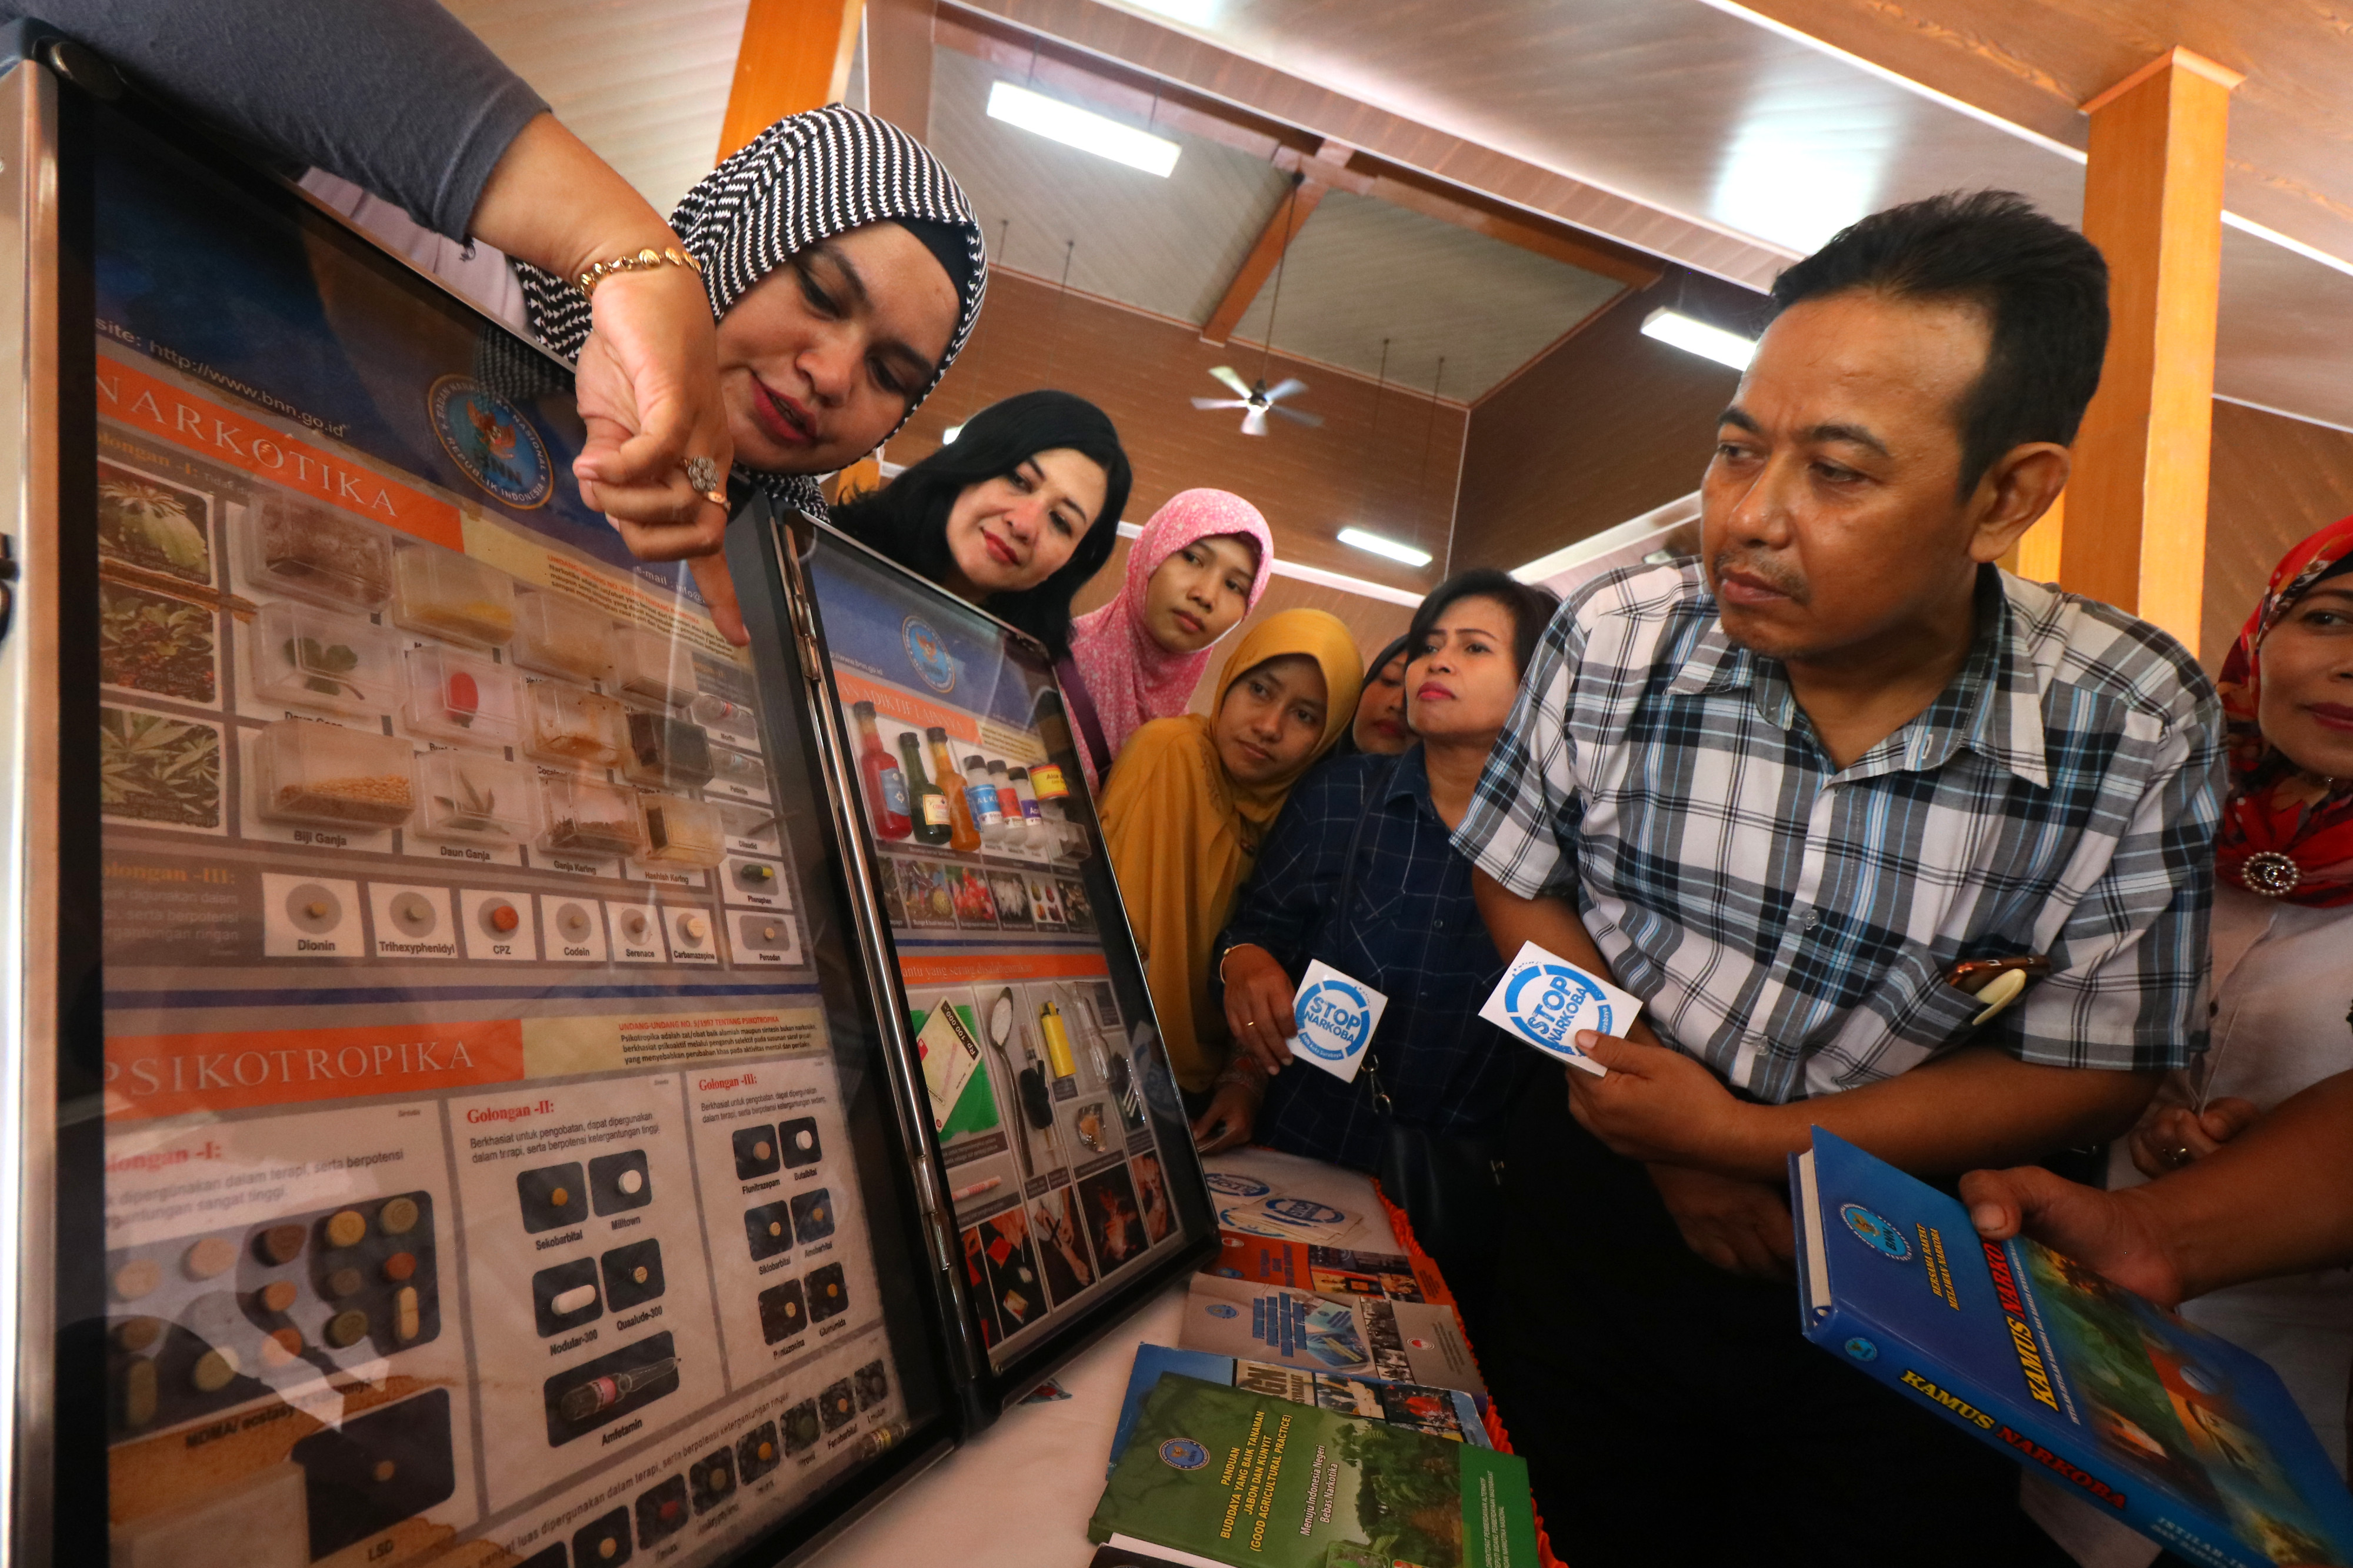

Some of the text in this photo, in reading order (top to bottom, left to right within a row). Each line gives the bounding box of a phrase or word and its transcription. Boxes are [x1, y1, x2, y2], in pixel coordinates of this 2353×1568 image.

[501, 483, 545, 502] INDONESIA
[636, 565, 666, 585] e-mail
[295, 830, 347, 848] Biji Ganja
[440, 846, 491, 862] Daun Ganja
[554, 860, 597, 875] Ganja Kering
[297, 939, 336, 952] Dionin
[379, 941, 455, 955] Trihexyphenidyl
[493, 945, 511, 955] CPZ
[564, 947, 590, 958] Codein
[625, 949, 655, 959] Serenace
[673, 950, 715, 960] Carbamazepine
[758, 953, 781, 962] Percodan
[902, 966, 922, 978] antu
[926, 966, 946, 980] yang
[950, 963, 975, 979] sering
[1310, 996, 1361, 1030] STOP
[1527, 976, 1571, 1035] STOP
[1548, 987, 1588, 1043] NARKOBA
[619, 1020, 679, 1031] UNDANG-UNDANG
[742, 1016, 779, 1025] PSIKOTROPIKA
[1304, 1011, 1354, 1043] NARKOBA
[621, 1033, 659, 1043] Psikotropika
[661, 1032, 681, 1040] adalah
[682, 1030, 705, 1040] zat/obat
[741, 1027, 761, 1036] maupun
[623, 1043, 656, 1053] berkhasiat
[658, 1041, 687, 1051] psikoaktif
[688, 1040, 708, 1048] melalui
[709, 1038, 734, 1048] pengaruh
[735, 1036, 753, 1045] selektif
[754, 1036, 766, 1045] pada
[767, 1034, 786, 1042] susunan
[625, 1055, 642, 1066] yang
[642, 1051, 685, 1063] menyebabkan
[686, 1049, 716, 1059] perubahan
[716, 1047, 729, 1056] khas
[730, 1046, 743, 1056] pada
[744, 1044, 765, 1053] aktivitas
[765, 1042, 781, 1051] mental
[699, 1073, 756, 1091] Golongan -III:
[467, 1100, 554, 1123] Golongan -II:
[701, 1099, 729, 1112] Berkhasiat
[731, 1097, 745, 1106] untuk
[775, 1091, 788, 1100] dapat
[702, 1113, 719, 1123] dalam
[738, 1107, 751, 1116] serta
[752, 1103, 776, 1115] berpotensi
[471, 1134, 514, 1149] Berkhasiat
[516, 1130, 538, 1142] untuk
[587, 1119, 607, 1130] dapat
[608, 1112, 652, 1127] dipergunakan
[472, 1151, 498, 1163] dalam
[527, 1143, 546, 1154] serta
[548, 1136, 586, 1151] berpotensi
[314, 1160, 345, 1173] serta
[348, 1149, 404, 1169] berpotensi
[794, 1167, 818, 1180] Butalbital
[742, 1178, 781, 1195] Flunitrazepam
[611, 1216, 641, 1230] Milltown
[536, 1229, 584, 1251] Sekobarbital
[1882, 1226, 1897, 1252] BNN
[758, 1255, 791, 1275] Siklobarbital
[1916, 1222, 1944, 1298] BERSAMA RAKYAT
[1939, 1265, 1960, 1312] MELAWAN
[617, 1305, 663, 1331] Quaalude-300
[1983, 1239, 2059, 1412] KAMUS NARKO
[601, 1417, 644, 1447] Amfetamin
[1900, 1370, 2126, 1510] KAMUS NARKOBA
[1220, 1410, 1265, 1539] BUDIDAYA YANG BAIK TANAMAN
[1221, 1447, 1241, 1486] PANDUAN
[1244, 1434, 1272, 1516] JABON DAN KUNYIT
[541, 1493, 605, 1537] dipergunakan
[607, 1479, 634, 1498] dalam
[682, 1430, 718, 1460] berpotensi
[1249, 1414, 1294, 1552] (GOOD AGRICULTURAL PRACTICE)
[1299, 1444, 1327, 1536] Menuju Indonesia Negeri
[1319, 1463, 1339, 1524] Bebas Narkotika
[368, 1539, 394, 1563] LSD
